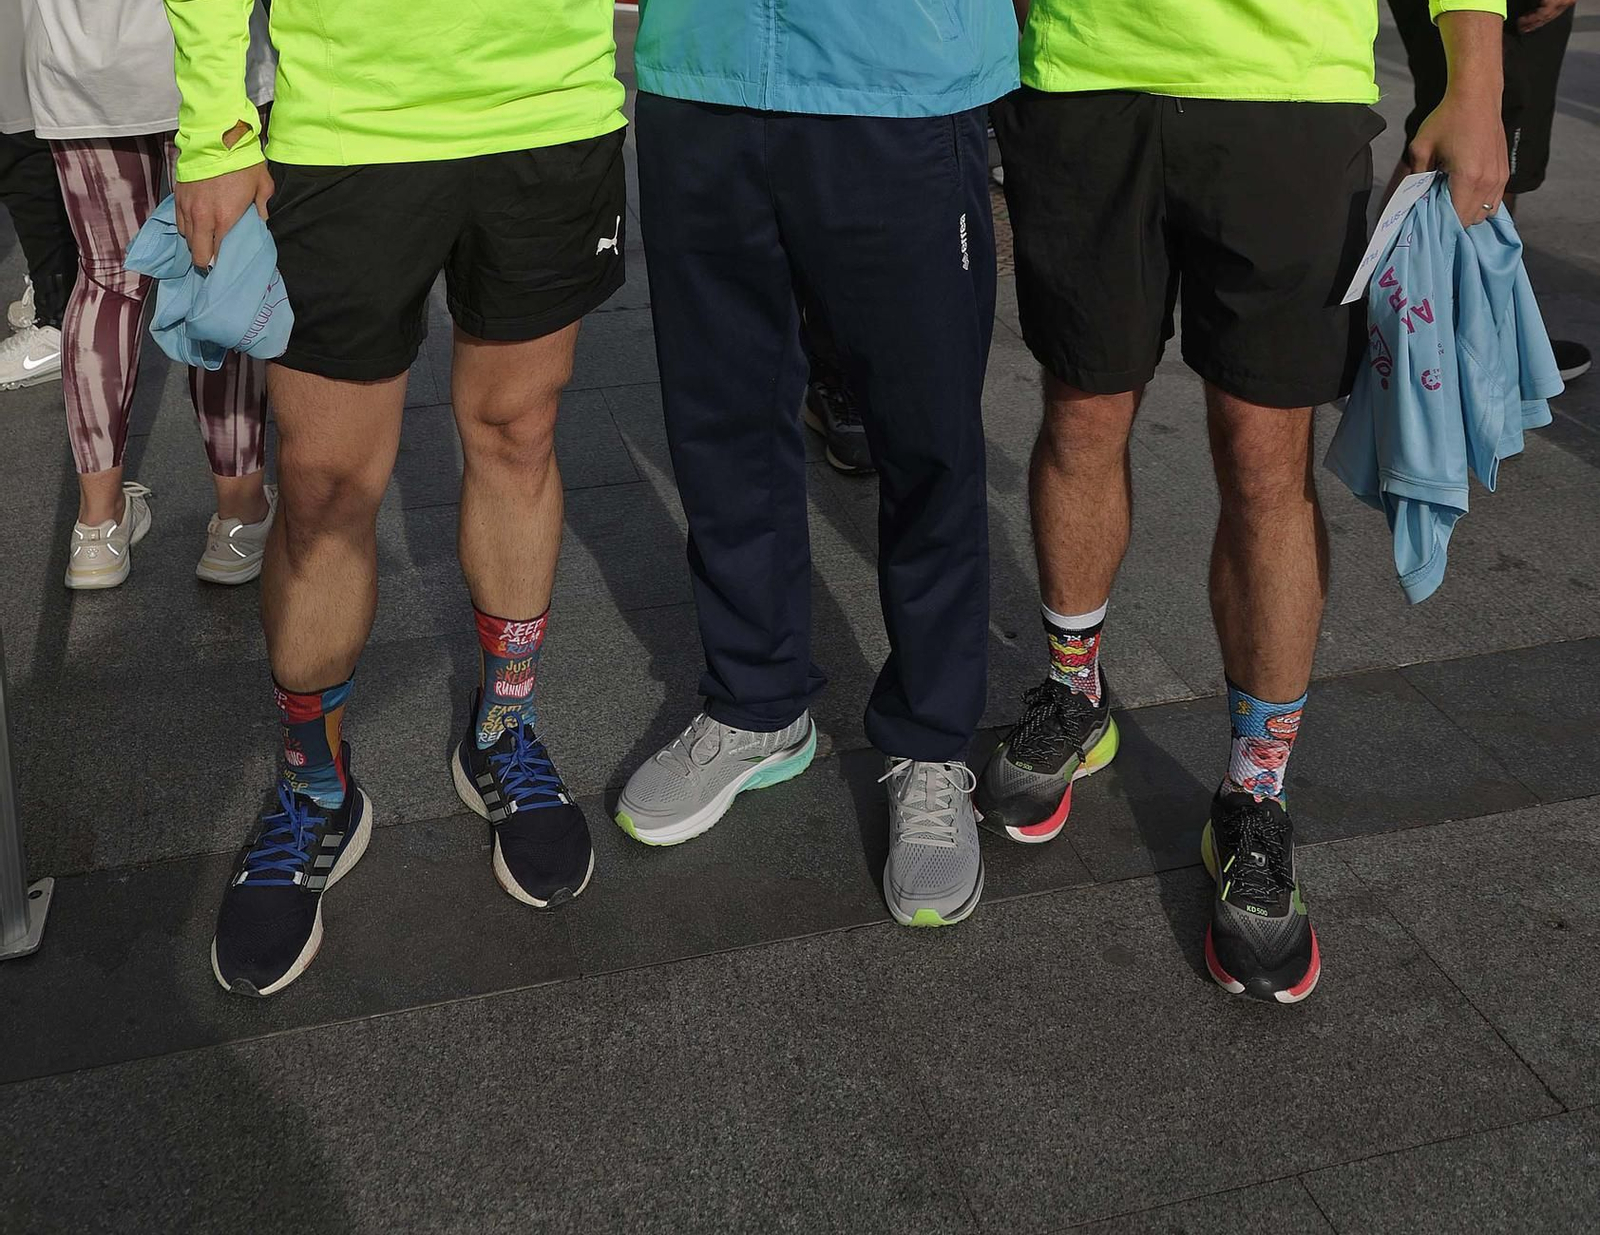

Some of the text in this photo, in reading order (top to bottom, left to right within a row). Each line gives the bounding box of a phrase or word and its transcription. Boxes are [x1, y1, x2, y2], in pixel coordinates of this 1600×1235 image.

[503, 618, 544, 637] KEEP
[506, 657, 533, 674] JUST
[504, 668, 531, 685] KEEP
[495, 677, 534, 698] RUNNING
